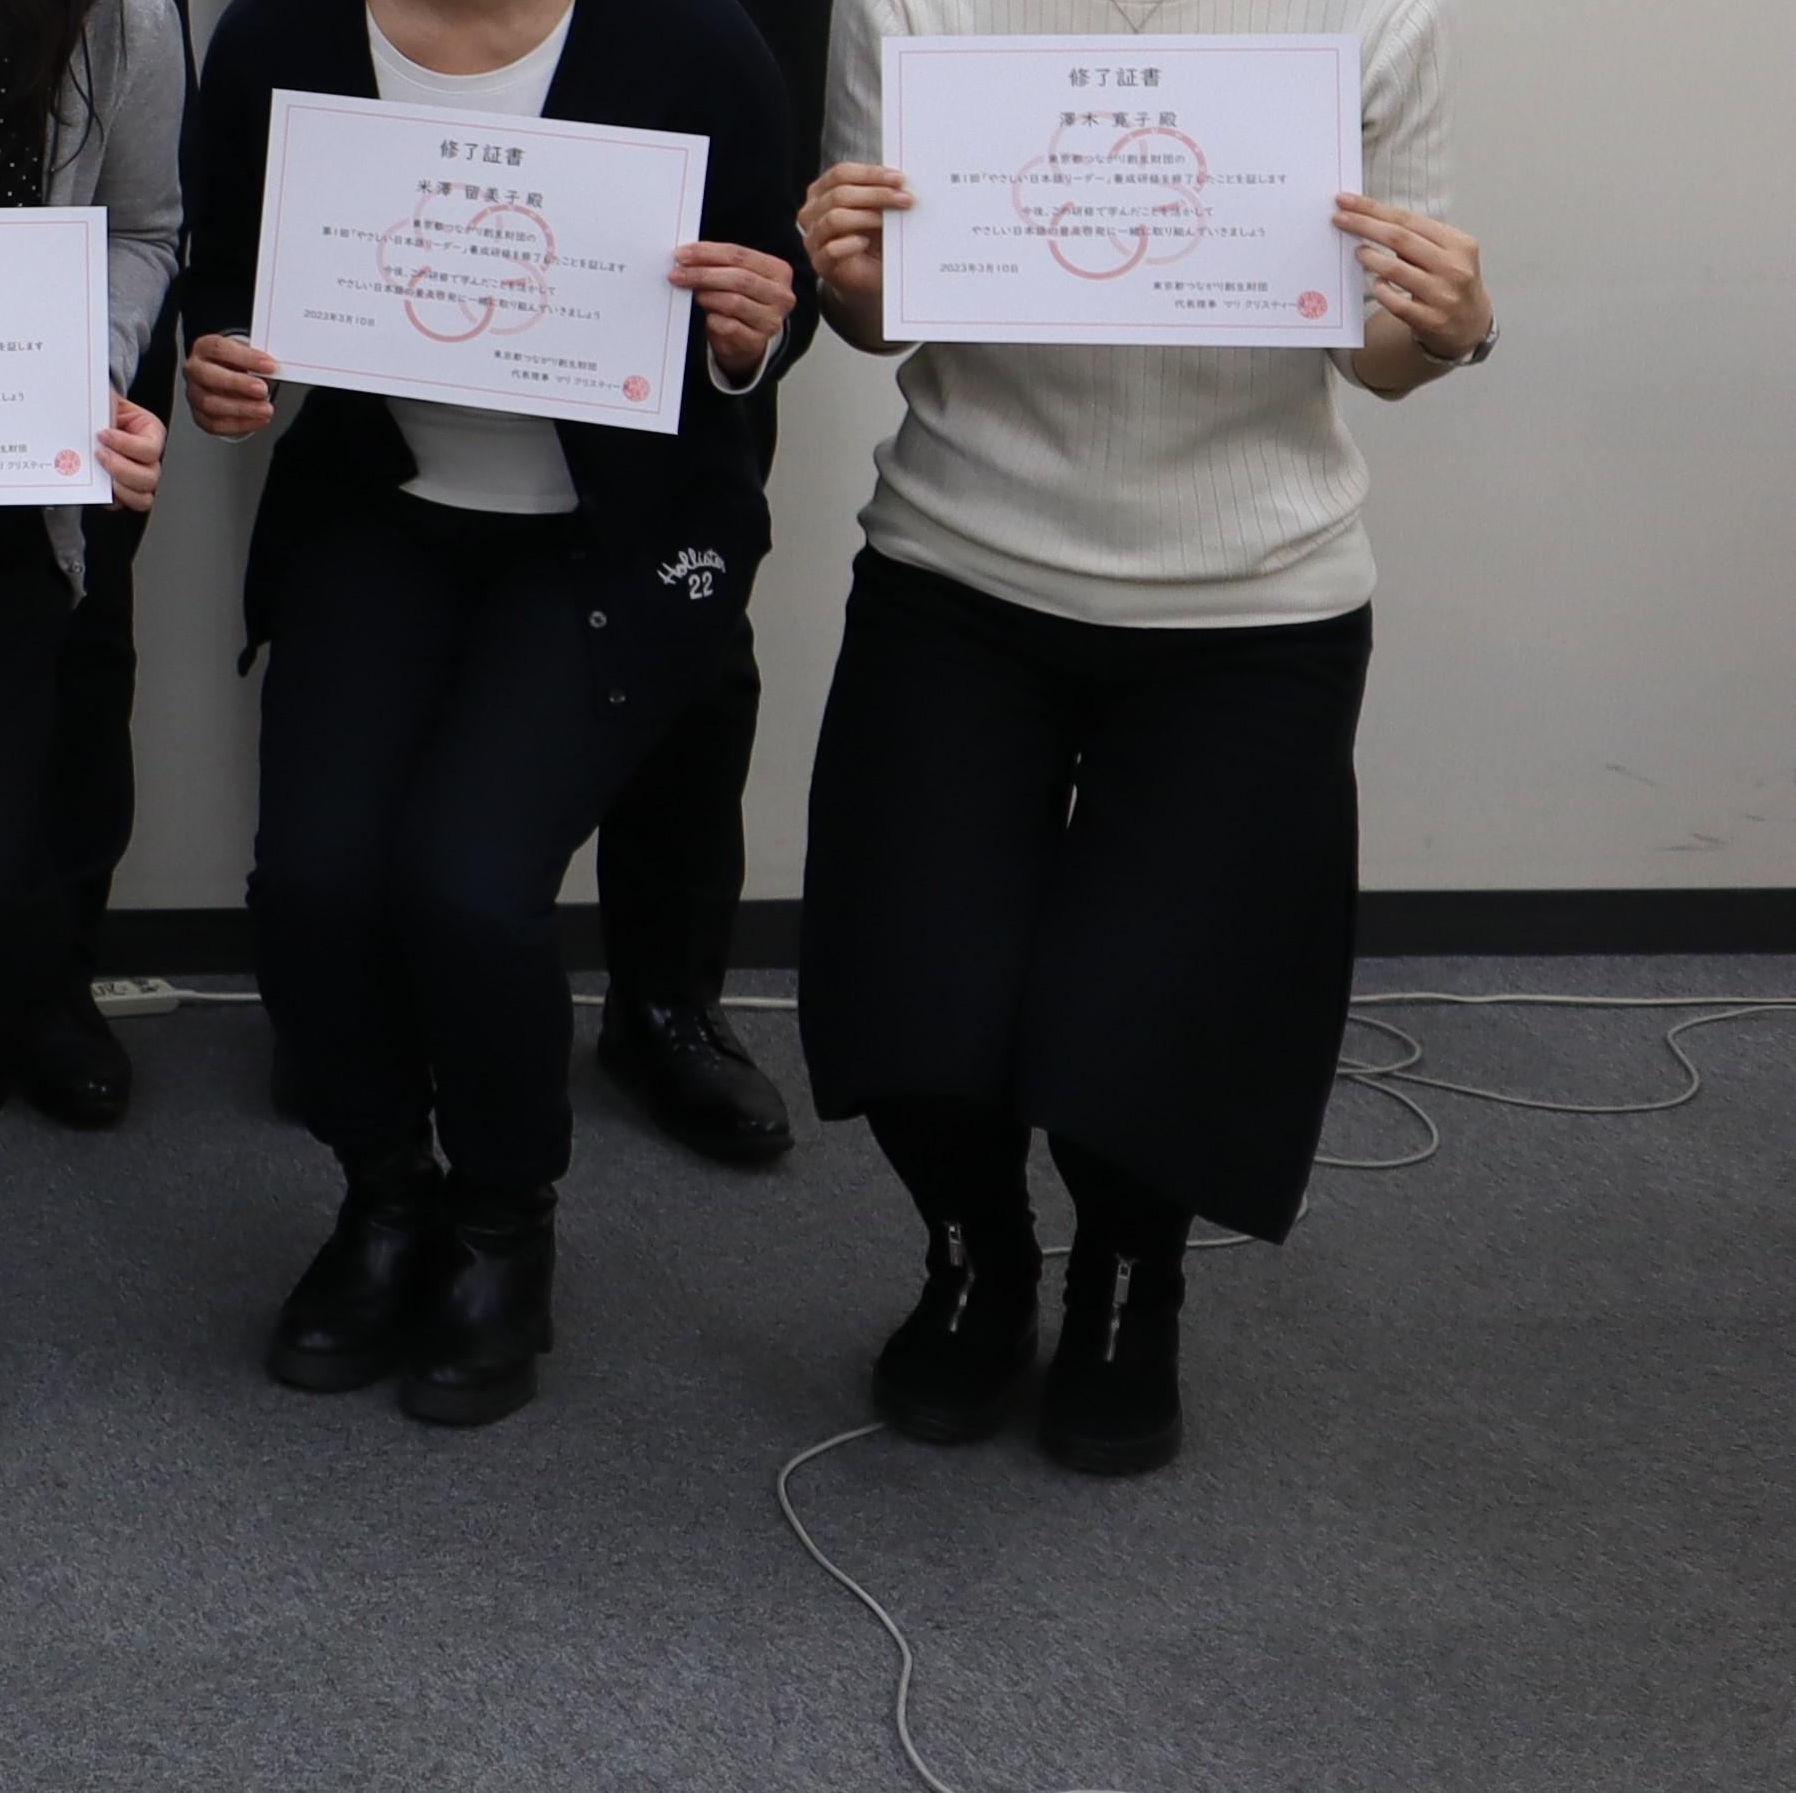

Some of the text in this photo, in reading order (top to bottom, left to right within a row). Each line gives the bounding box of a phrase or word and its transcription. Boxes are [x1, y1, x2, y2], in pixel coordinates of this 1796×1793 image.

[1069, 68, 1160, 87] 修了証書
[440, 140, 523, 166] 修了証書
[688, 572, 713, 600] 22
